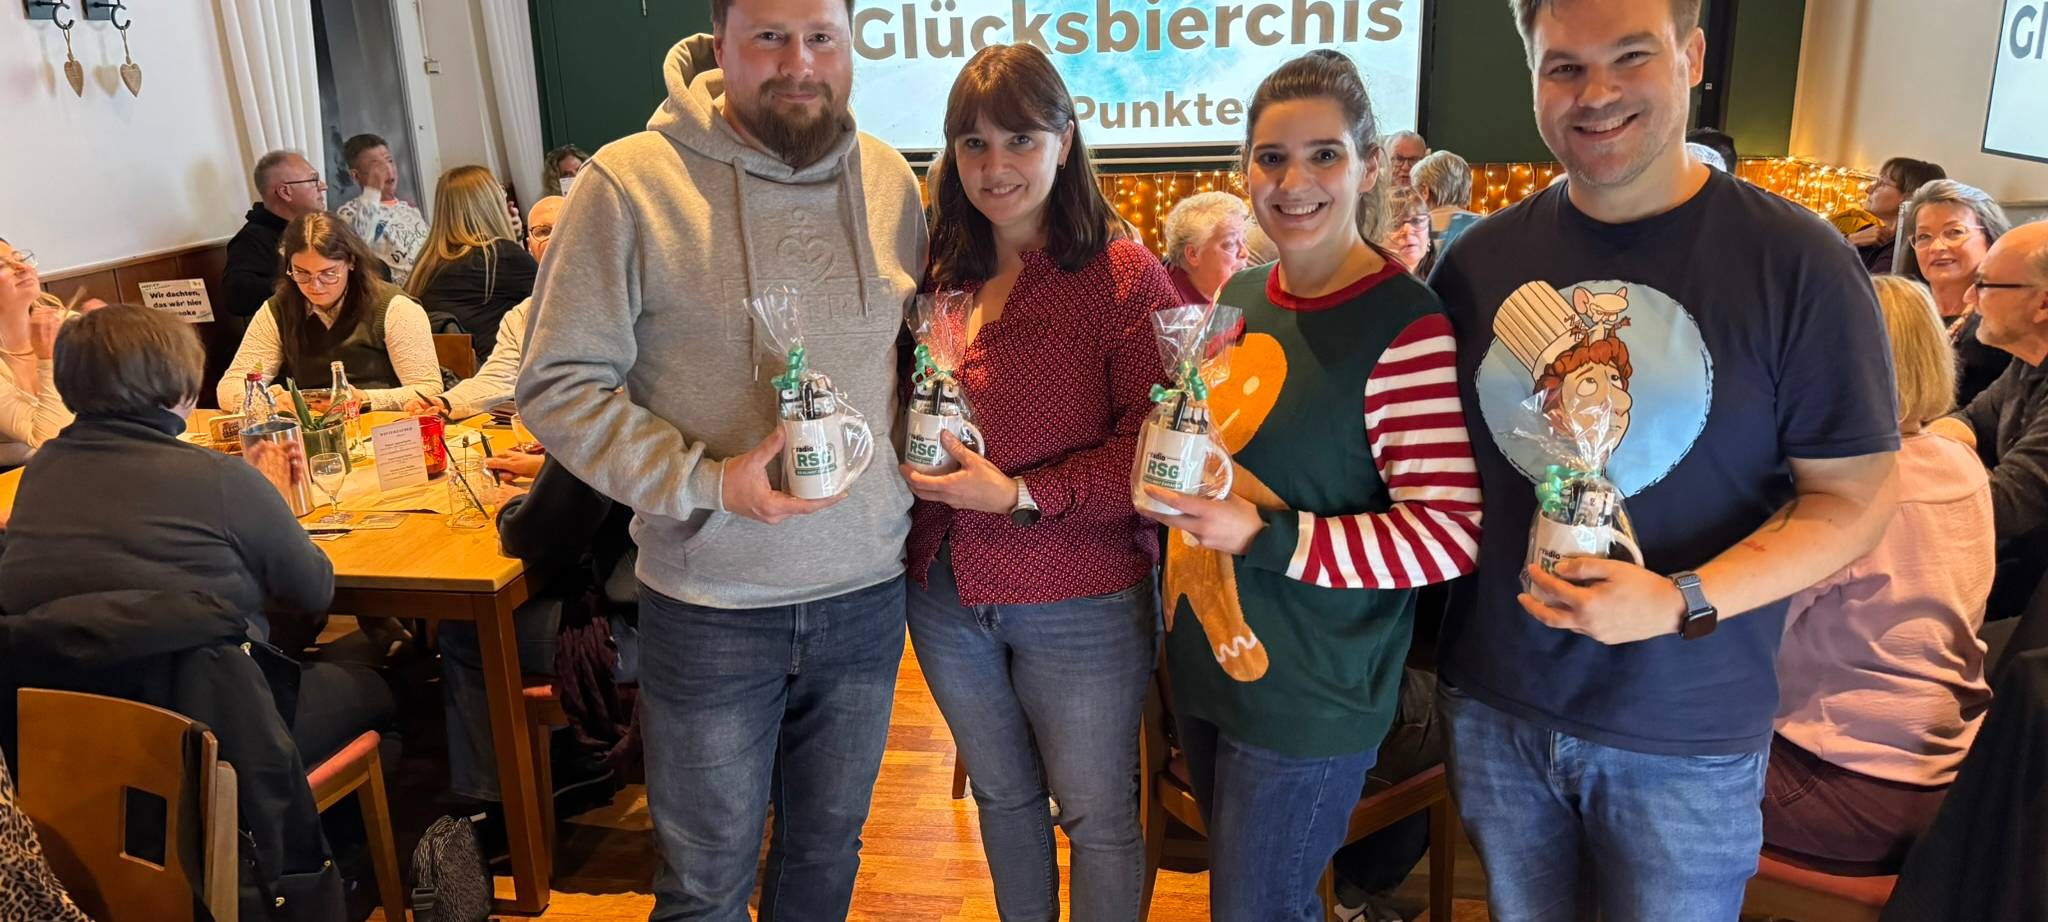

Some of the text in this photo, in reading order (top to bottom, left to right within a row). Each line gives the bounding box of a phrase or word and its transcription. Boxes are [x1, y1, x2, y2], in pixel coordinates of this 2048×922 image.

[853, 0, 1402, 60] Glücksbierchis
[1073, 91, 1243, 128] Punkte
[150, 290, 200, 299] Wir dachten,
[911, 434, 925, 442] radio
[910, 440, 938, 458] RSG
[1150, 452, 1166, 461] radio
[1147, 460, 1179, 479] RSG
[1542, 549, 1561, 560] radio
